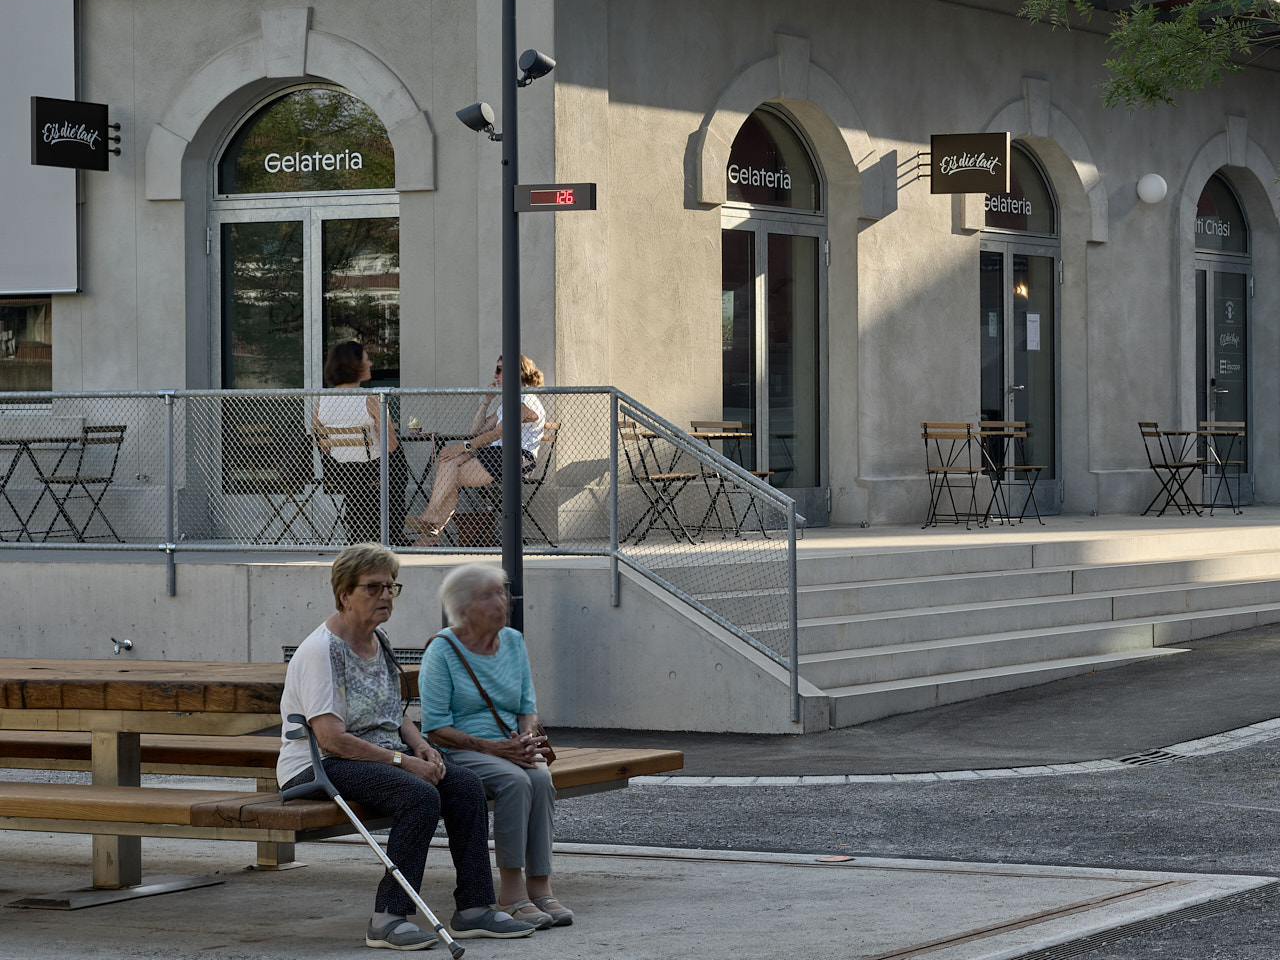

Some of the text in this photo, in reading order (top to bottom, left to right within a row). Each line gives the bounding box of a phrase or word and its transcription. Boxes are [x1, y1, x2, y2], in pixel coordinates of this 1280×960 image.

[264, 149, 362, 173] Gelateria
[728, 164, 792, 189] Gelateria
[984, 194, 1032, 215] Gelateria
[1205, 219, 1231, 237] Chäsi
